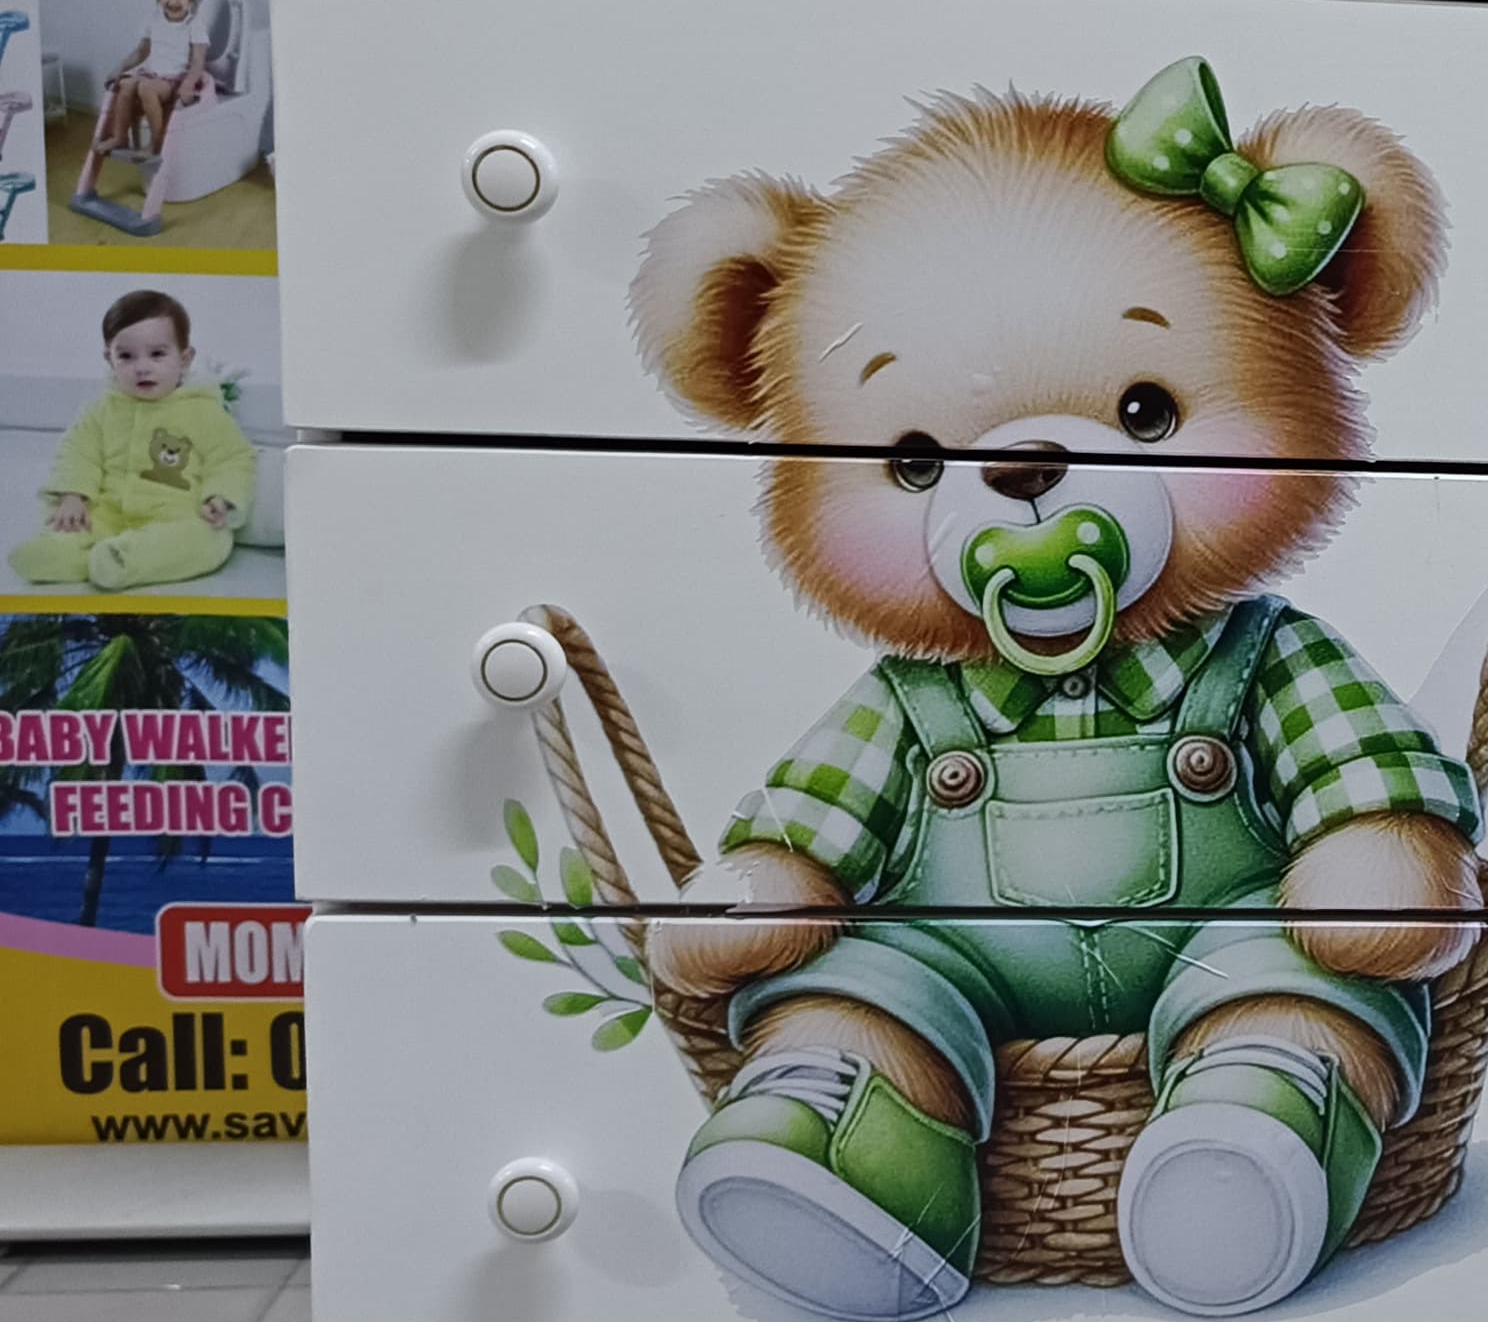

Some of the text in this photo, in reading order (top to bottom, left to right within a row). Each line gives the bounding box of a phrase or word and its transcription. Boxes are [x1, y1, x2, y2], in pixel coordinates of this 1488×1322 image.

[124, 712, 292, 764] WALKE
[54, 784, 249, 833] FEEDING
[59, 1012, 248, 1095] Call:
